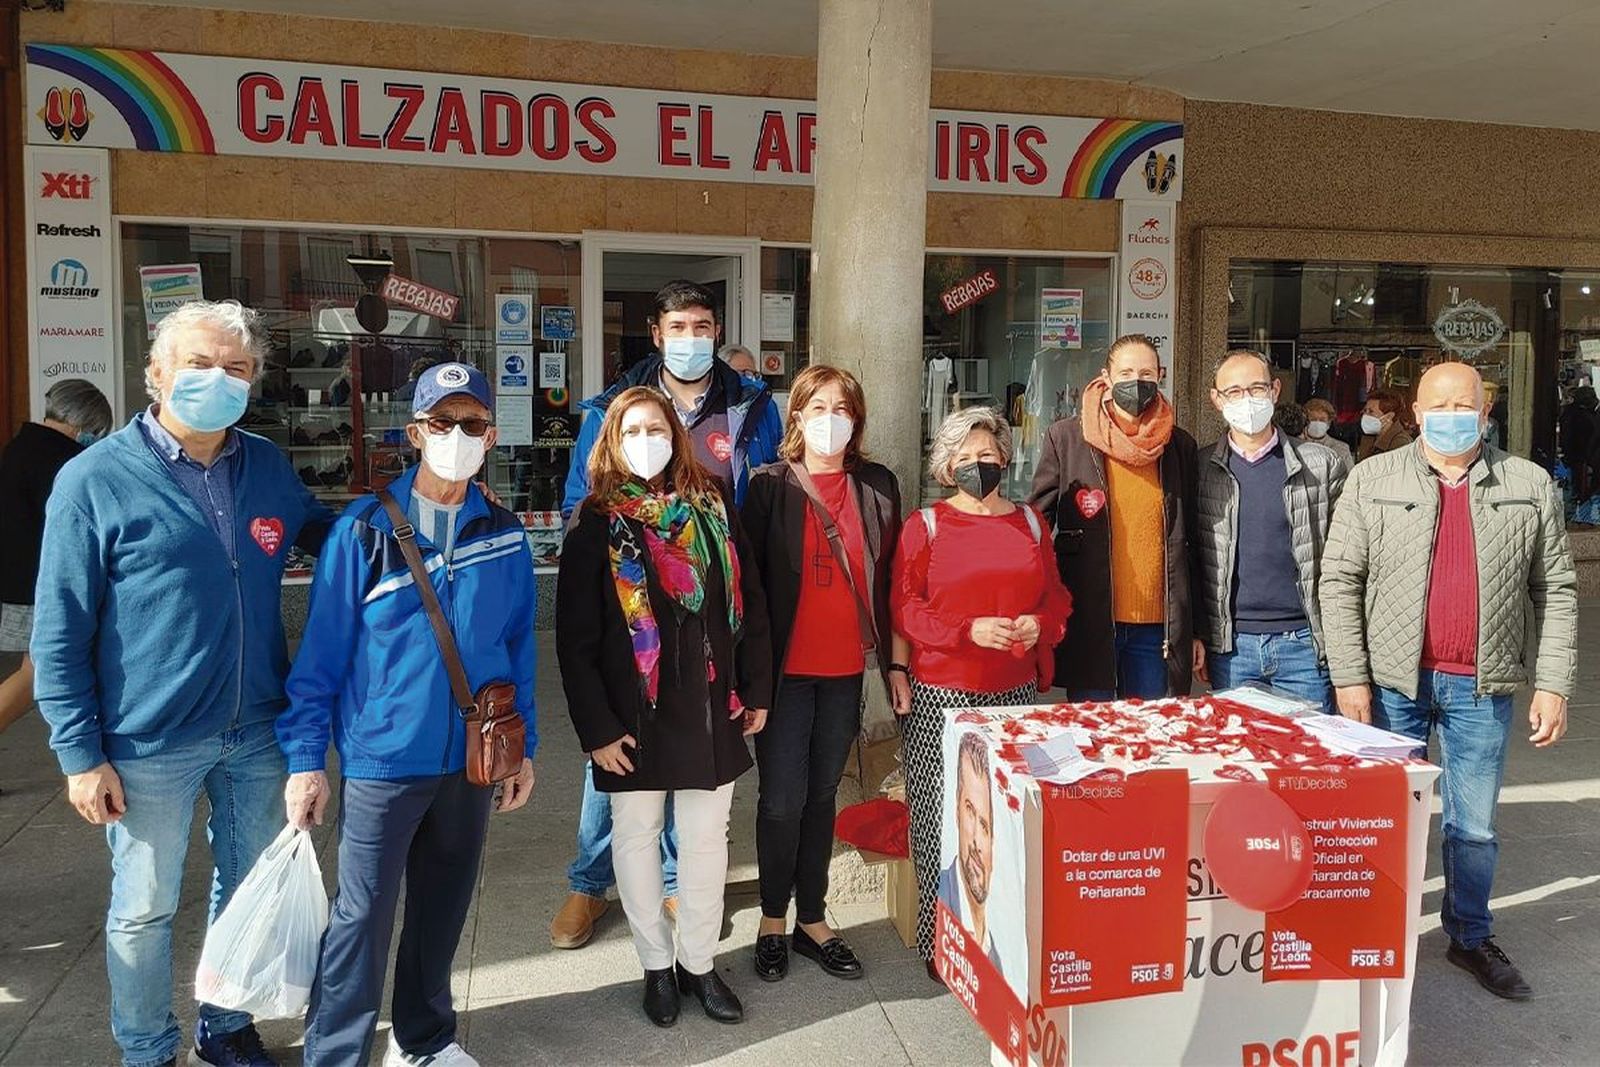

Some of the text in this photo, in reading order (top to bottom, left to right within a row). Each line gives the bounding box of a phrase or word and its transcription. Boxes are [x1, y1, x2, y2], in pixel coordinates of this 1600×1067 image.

[237, 72, 618, 164] CALZADOS
[657, 102, 731, 170] EL
[935, 120, 1049, 186] IRIS
[41, 172, 95, 200] Xti
[703, 191, 709, 205] 1
[37, 223, 101, 238] Refresh
[40, 286, 100, 298] mustang
[384, 278, 455, 317] REBAJAS
[943, 272, 996, 312] REBAJAS
[40, 327, 105, 337] MARIAMARE
[1443, 321, 1495, 339] REBAJAS
[1338, 817, 1395, 830] Viviendas
[1246, 838, 1281, 851] PSOE
[1314, 835, 1378, 847] Protección
[1062, 847, 1166, 863] Dotar de una UVI
[1348, 854, 1364, 864] en
[1066, 866, 1161, 882] a la comarca de
[1360, 868, 1376, 881] de
[1079, 884, 1146, 899] Peñaranda
[942, 910, 965, 949] Vota
[1272, 930, 1297, 941] Vota
[1271, 940, 1312, 953] Castilla
[941, 934, 980, 992] Castilla
[1050, 950, 1076, 962] Vota
[1271, 950, 1312, 966] y León.
[1351, 954, 1381, 967] PSOE
[941, 957, 949, 978] y
[1049, 960, 1092, 975] Castilla
[1050, 972, 1092, 989] y León.
[1131, 969, 1160, 983] PSOE
